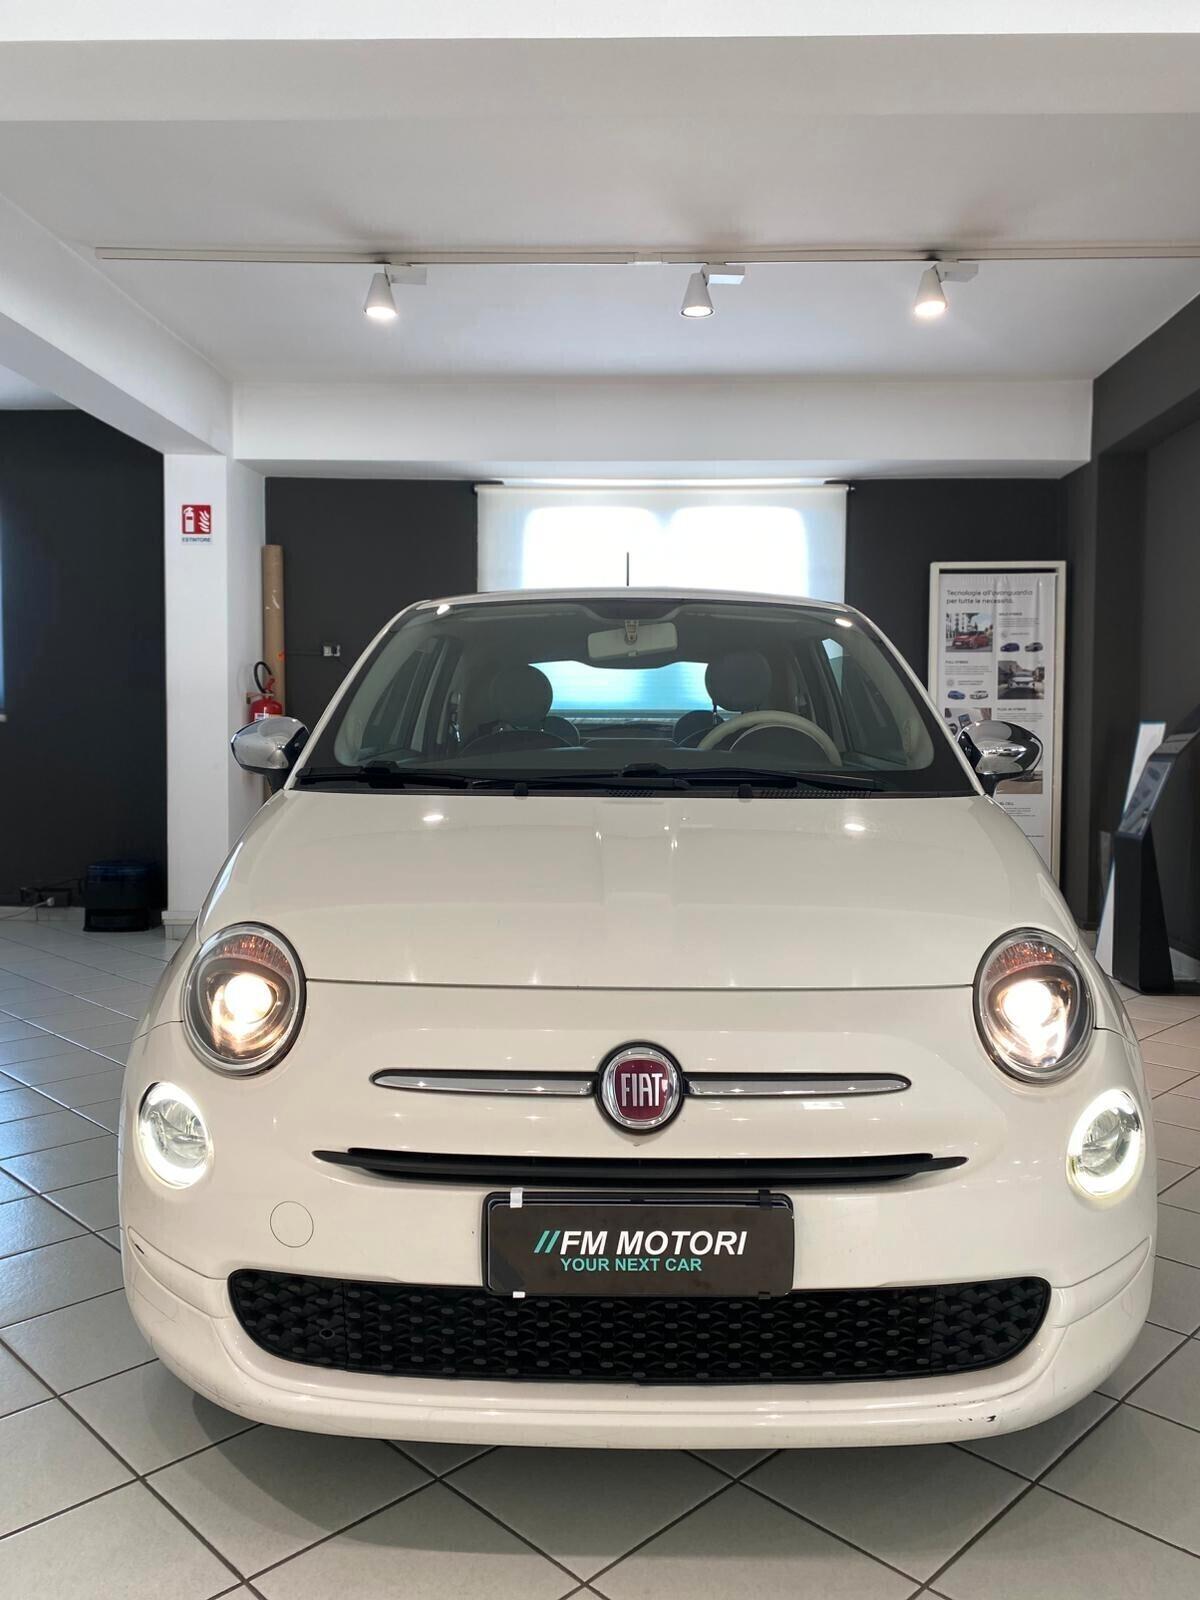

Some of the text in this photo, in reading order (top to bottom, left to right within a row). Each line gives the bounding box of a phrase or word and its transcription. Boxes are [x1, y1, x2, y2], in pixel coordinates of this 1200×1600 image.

[621, 1073, 663, 1107] FIAT
[616, 1230, 747, 1256] MOTORI
[560, 1258, 702, 1272] YOUR NEXT CAR
